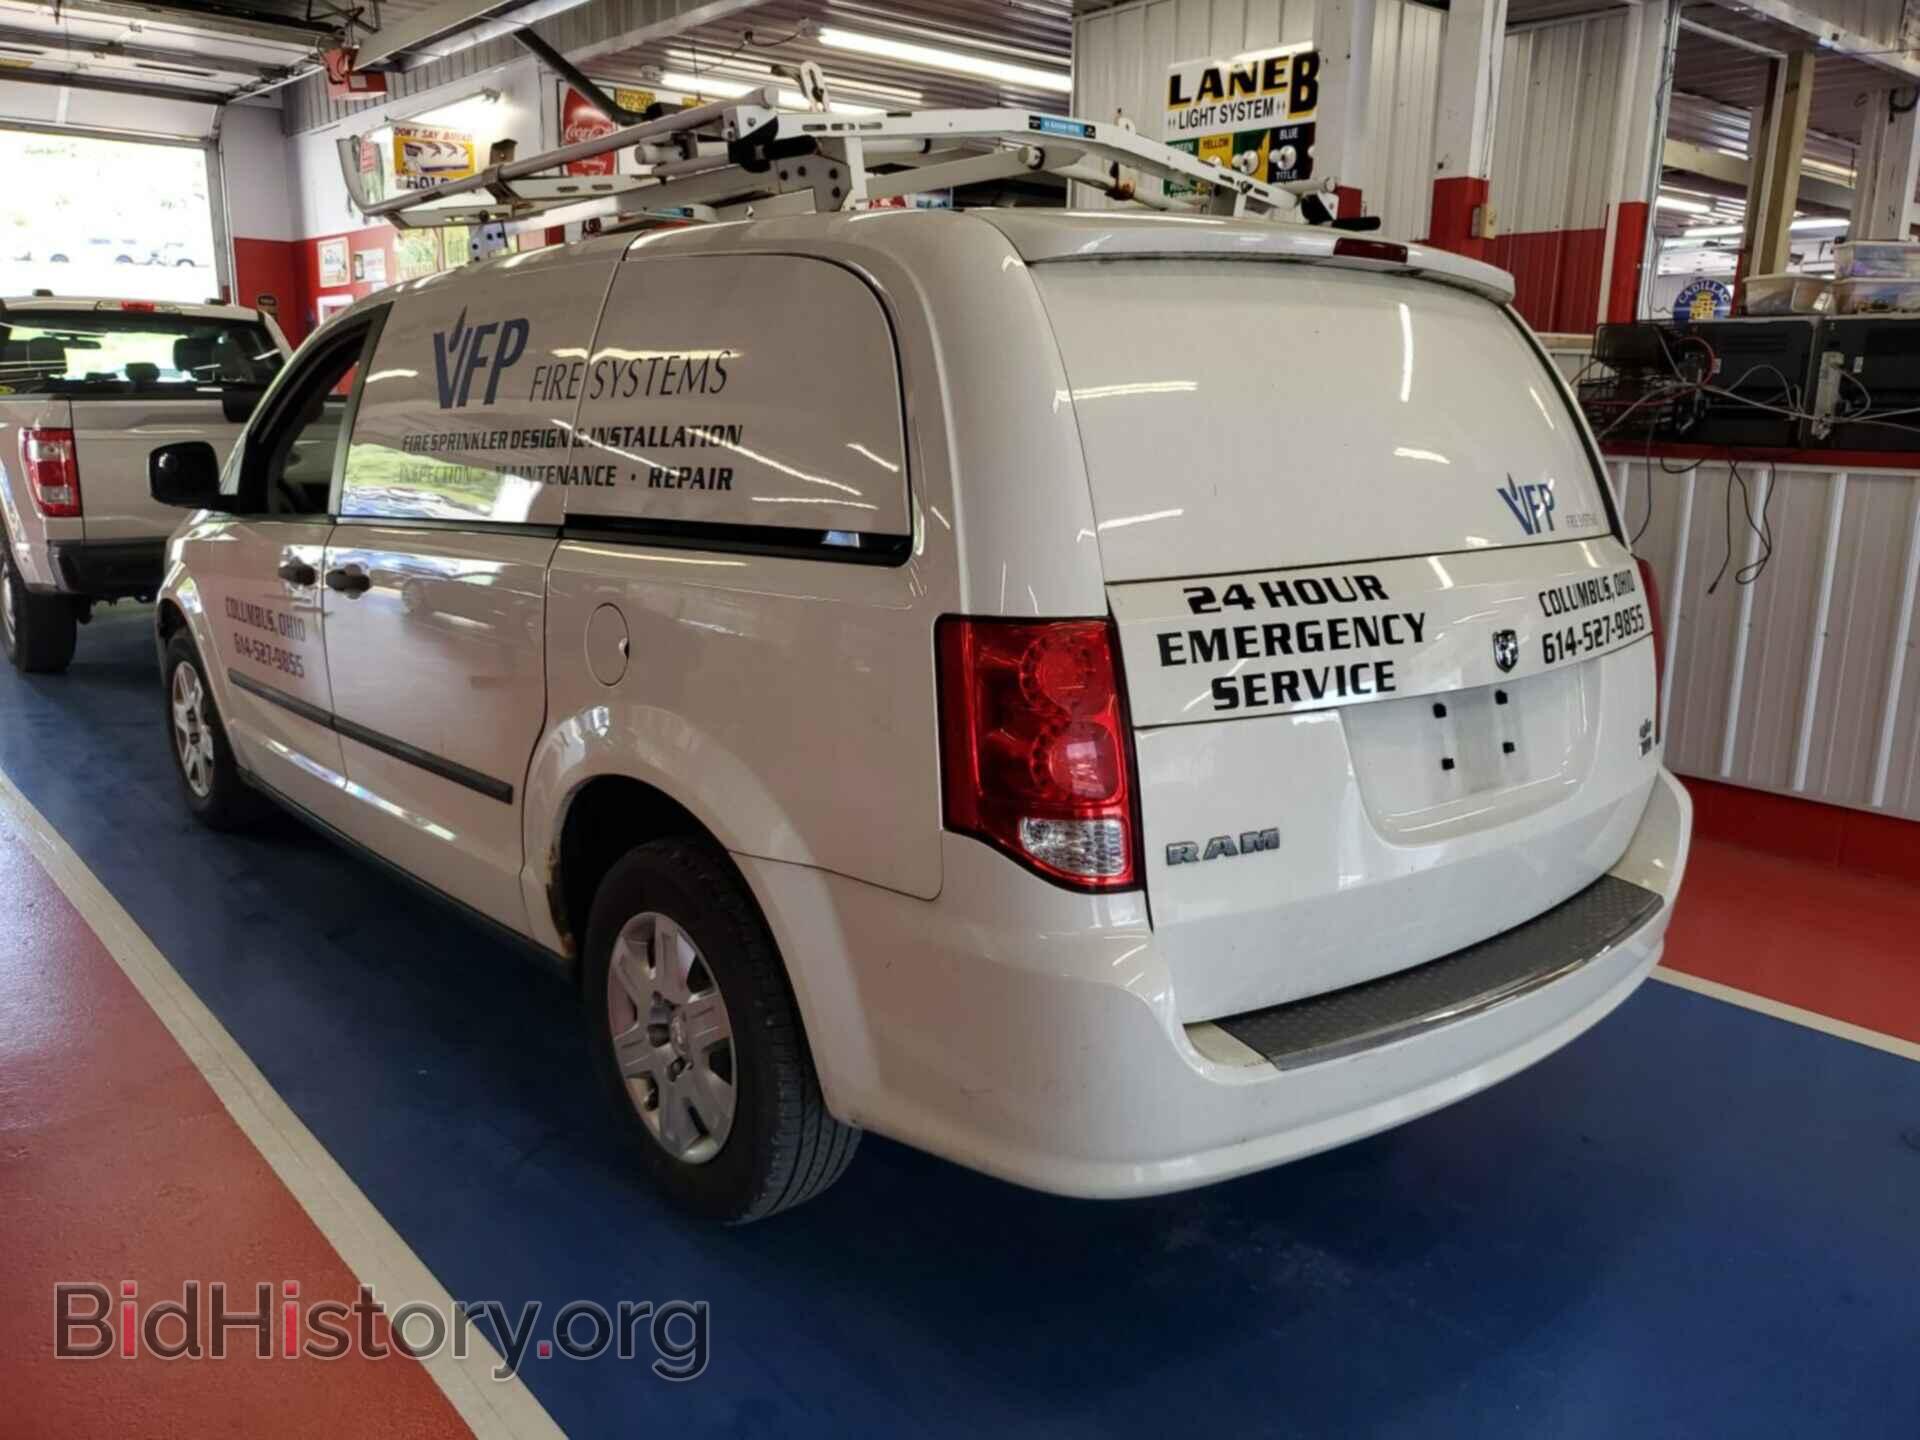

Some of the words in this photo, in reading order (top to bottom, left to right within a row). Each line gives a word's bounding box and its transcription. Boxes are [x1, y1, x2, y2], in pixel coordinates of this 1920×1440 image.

[1168, 56, 1290, 106] LANE
[1290, 51, 1320, 116] B
[1178, 105, 1216, 129] LIGHT
[1219, 96, 1275, 124] SYSTEM
[1203, 137, 1230, 149] YELLOW
[1279, 127, 1299, 140] BLUE
[1276, 170, 1298, 180] TITLE
[433, 303, 529, 410] VFP
[529, 361, 582, 402] FIRE
[590, 350, 732, 400] SYSTEMS
[510, 427, 569, 450] DESIGN
[590, 424, 742, 447] INSTALLATION
[648, 467, 734, 491] REPAIR
[1496, 472, 1555, 535] VFP
[1183, 584, 1255, 614] 24
[1258, 575, 1389, 608] HOUR
[1156, 612, 1426, 667] EMERGENCY
[1542, 604, 1645, 664] 614-527-9855
[1211, 660, 1396, 711] SERVICE
[1166, 827, 1280, 866] RAM
